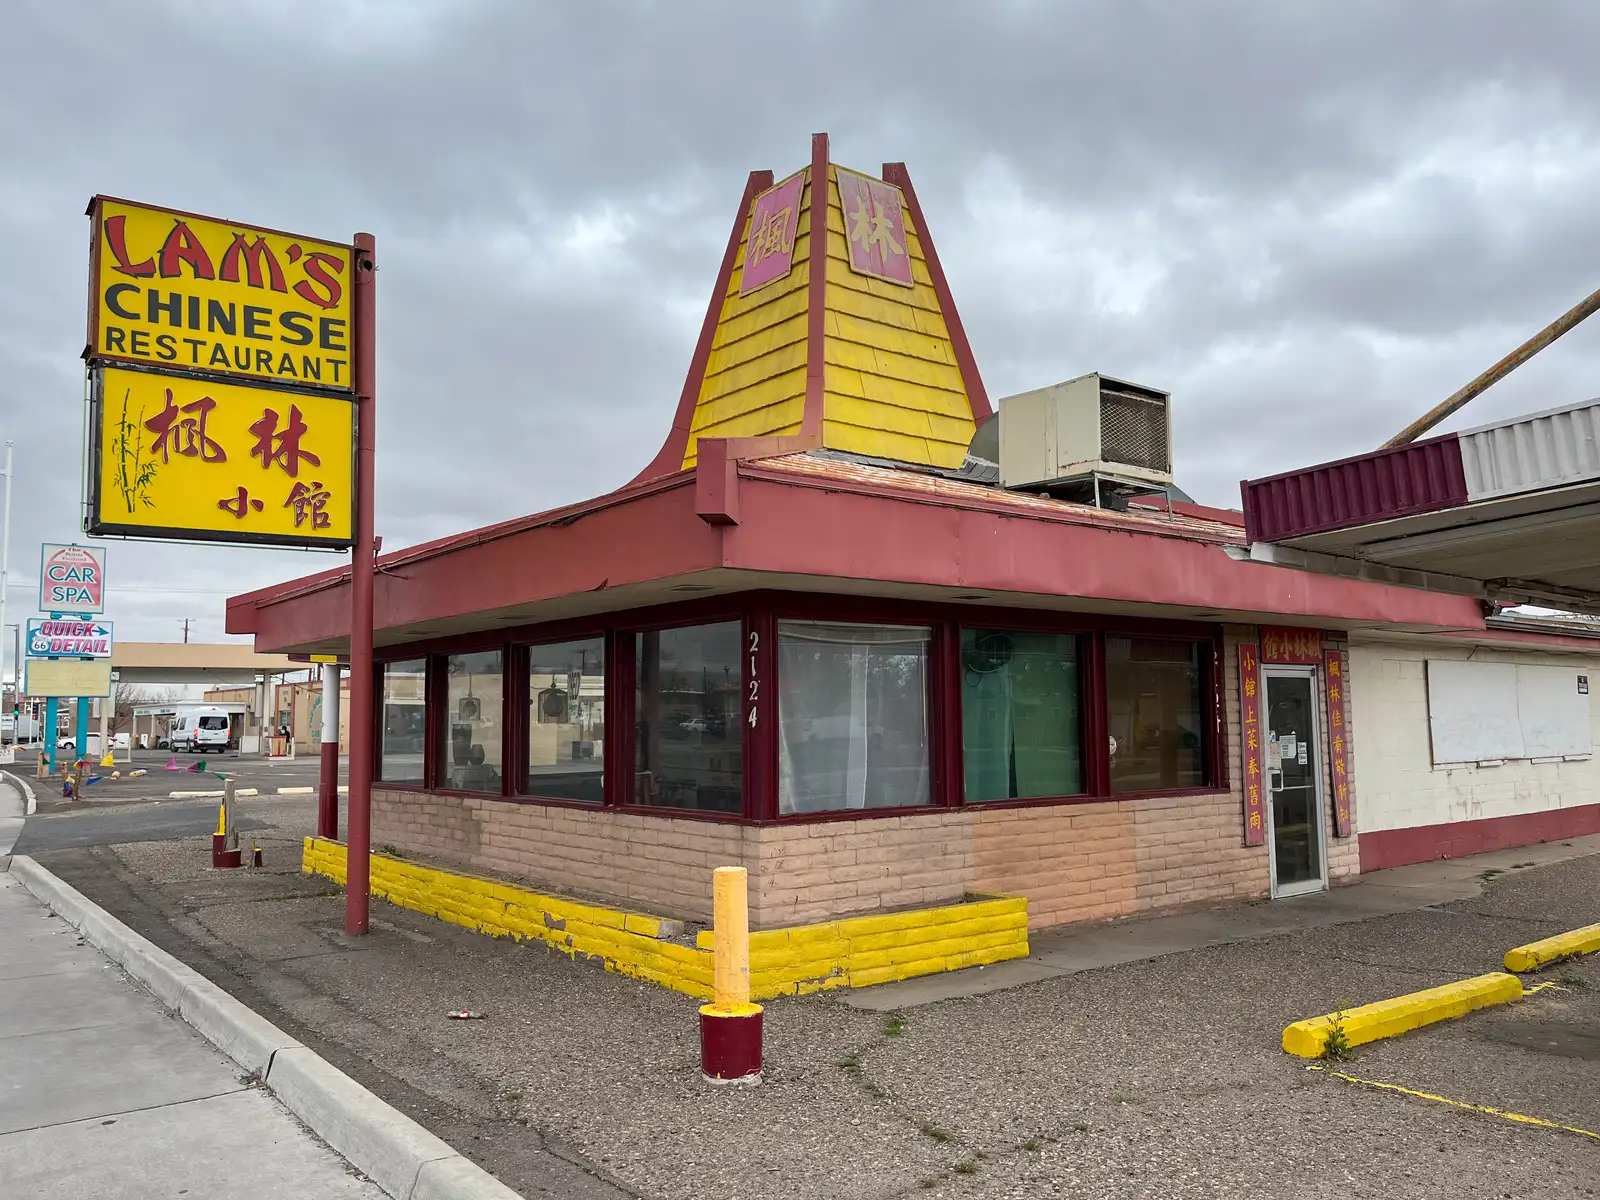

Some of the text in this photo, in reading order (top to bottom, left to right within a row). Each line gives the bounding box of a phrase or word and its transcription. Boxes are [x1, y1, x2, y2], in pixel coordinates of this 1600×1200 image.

[748, 206, 792, 269] 楓
[849, 198, 904, 263] 林
[103, 214, 345, 311] LAM'S
[104, 282, 347, 352] CHINESE
[105, 326, 347, 383] RESTAURANT
[216, 481, 332, 531] 小館
[48, 565, 95, 583] CAR
[51, 585, 93, 603] SPA
[34, 641, 47, 650] 66
[41, 621, 96, 637] QUICK
[50, 638, 109, 653] DETAIL
[748, 631, 760, 729] 2124
